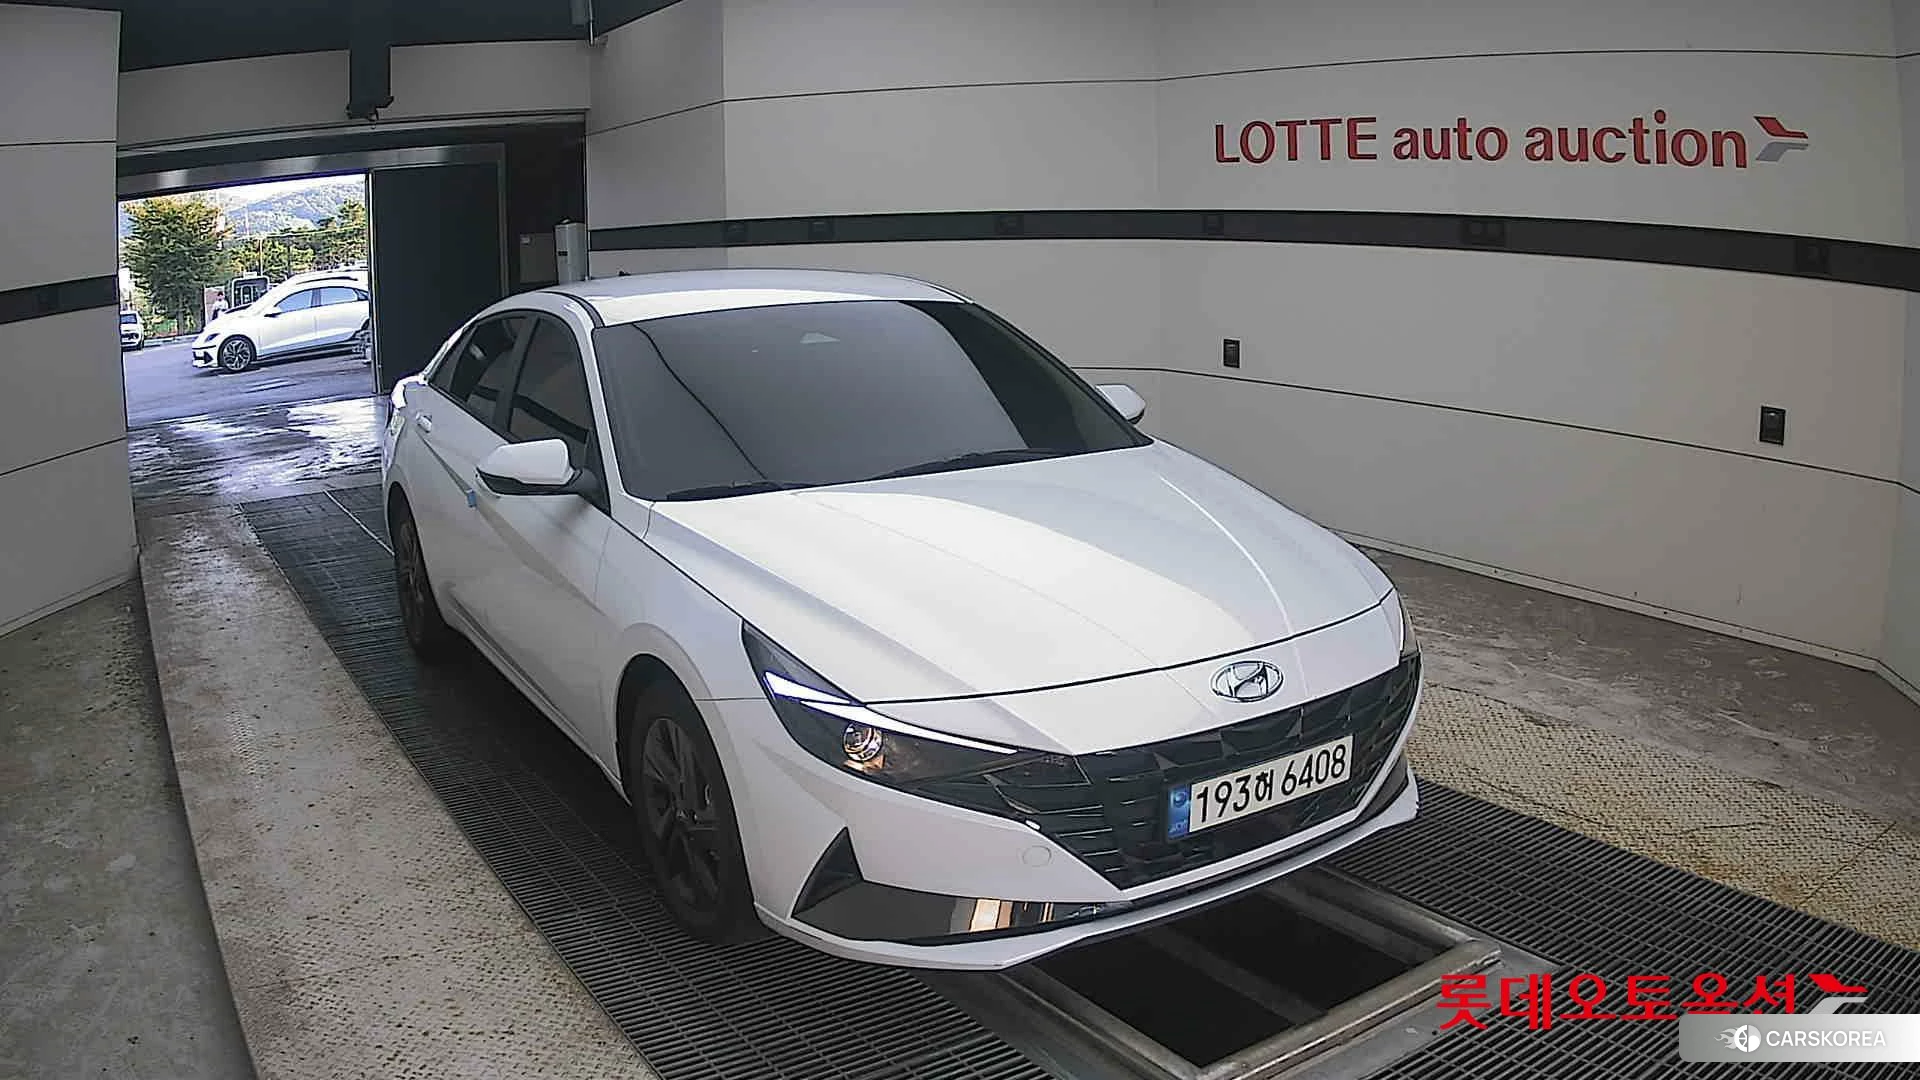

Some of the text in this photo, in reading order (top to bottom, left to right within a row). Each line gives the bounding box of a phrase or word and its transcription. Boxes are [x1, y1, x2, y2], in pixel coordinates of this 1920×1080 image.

[1214, 109, 1748, 169] LOTTE auto auction
[1196, 743, 1347, 824] 193허 6408
